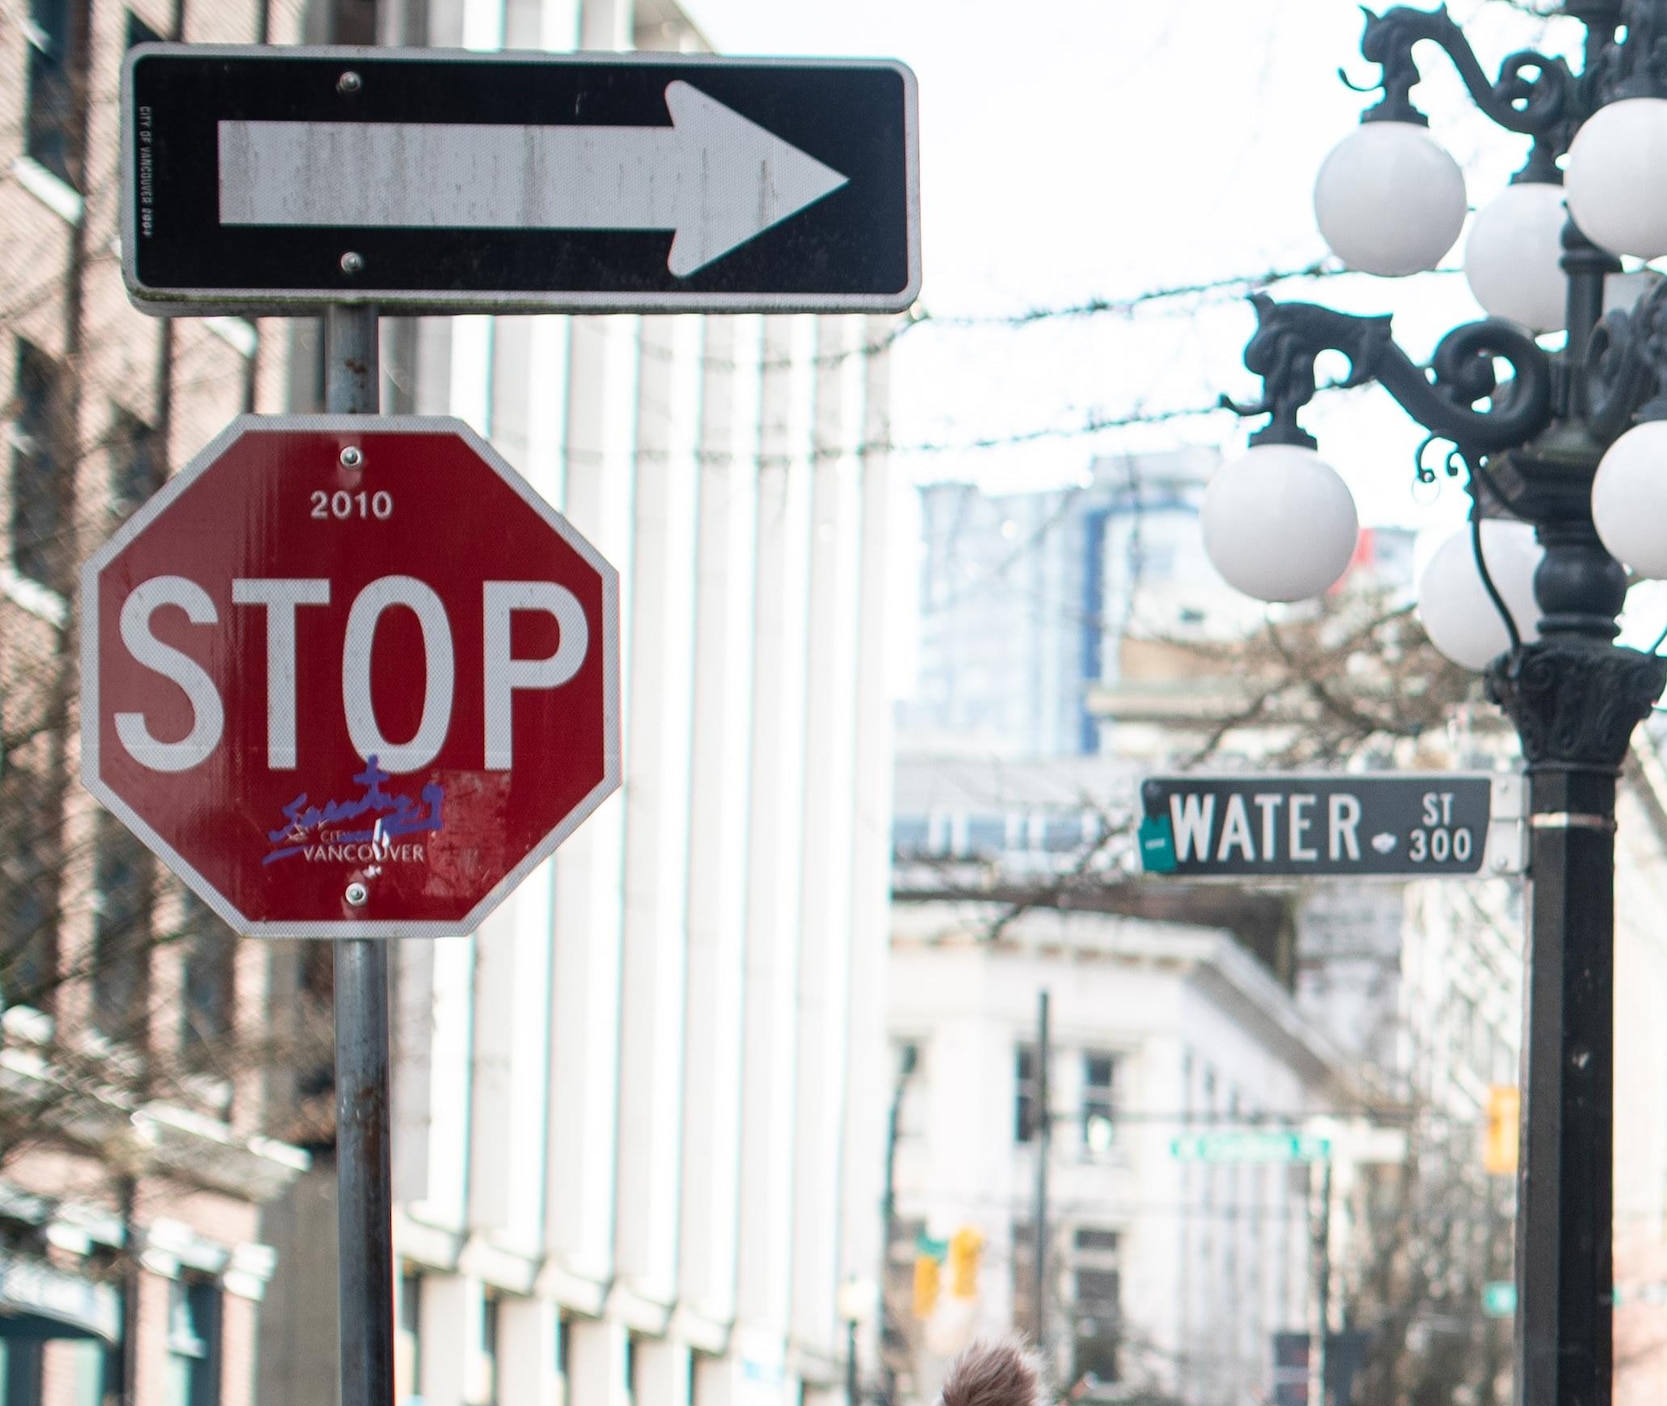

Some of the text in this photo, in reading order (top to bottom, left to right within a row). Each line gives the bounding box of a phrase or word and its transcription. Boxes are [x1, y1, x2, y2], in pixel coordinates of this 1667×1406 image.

[140, 146, 153, 204] VANCOUVER
[309, 491, 393, 519] 2010
[113, 574, 590, 773] STOP
[1169, 792, 1363, 863] WATER
[1422, 792, 1454, 827] ST
[303, 844, 425, 862] VANCOUVER
[1408, 827, 1473, 863] 300
